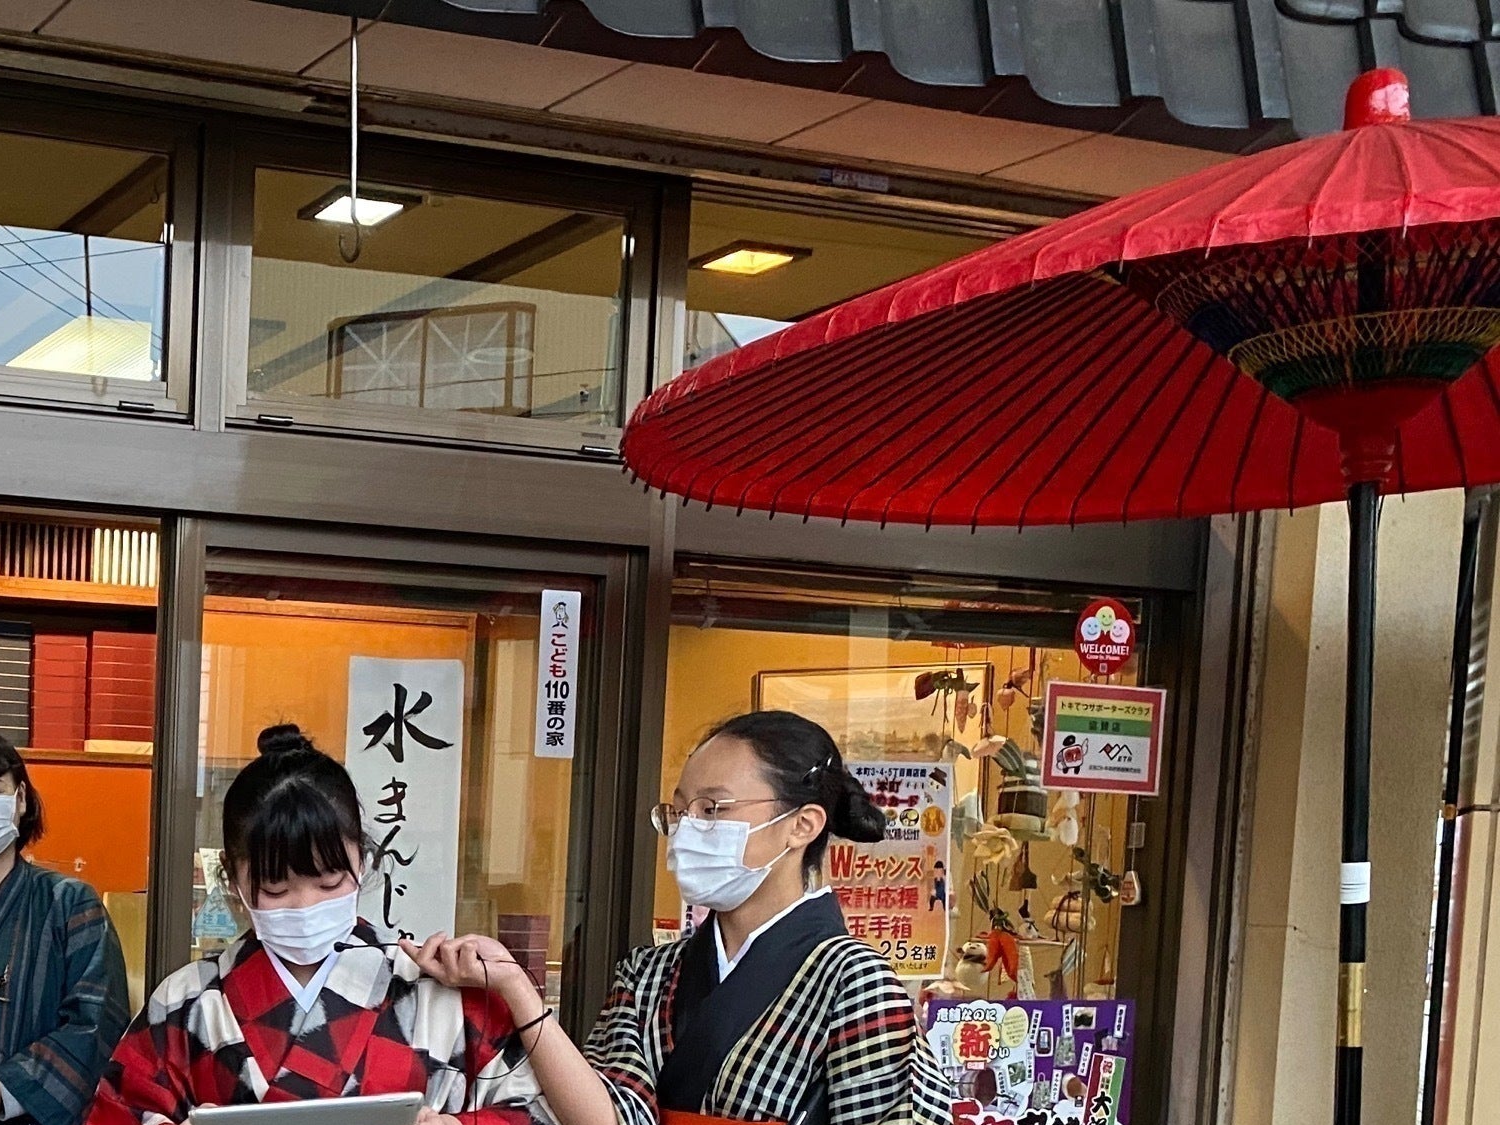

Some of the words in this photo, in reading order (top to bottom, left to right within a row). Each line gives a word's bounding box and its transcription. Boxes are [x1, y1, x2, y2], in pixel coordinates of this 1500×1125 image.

[1079, 643, 1130, 656] WELCOME!
[544, 632, 570, 747] こども110番の家
[848, 915, 913, 940] 玉手箱
